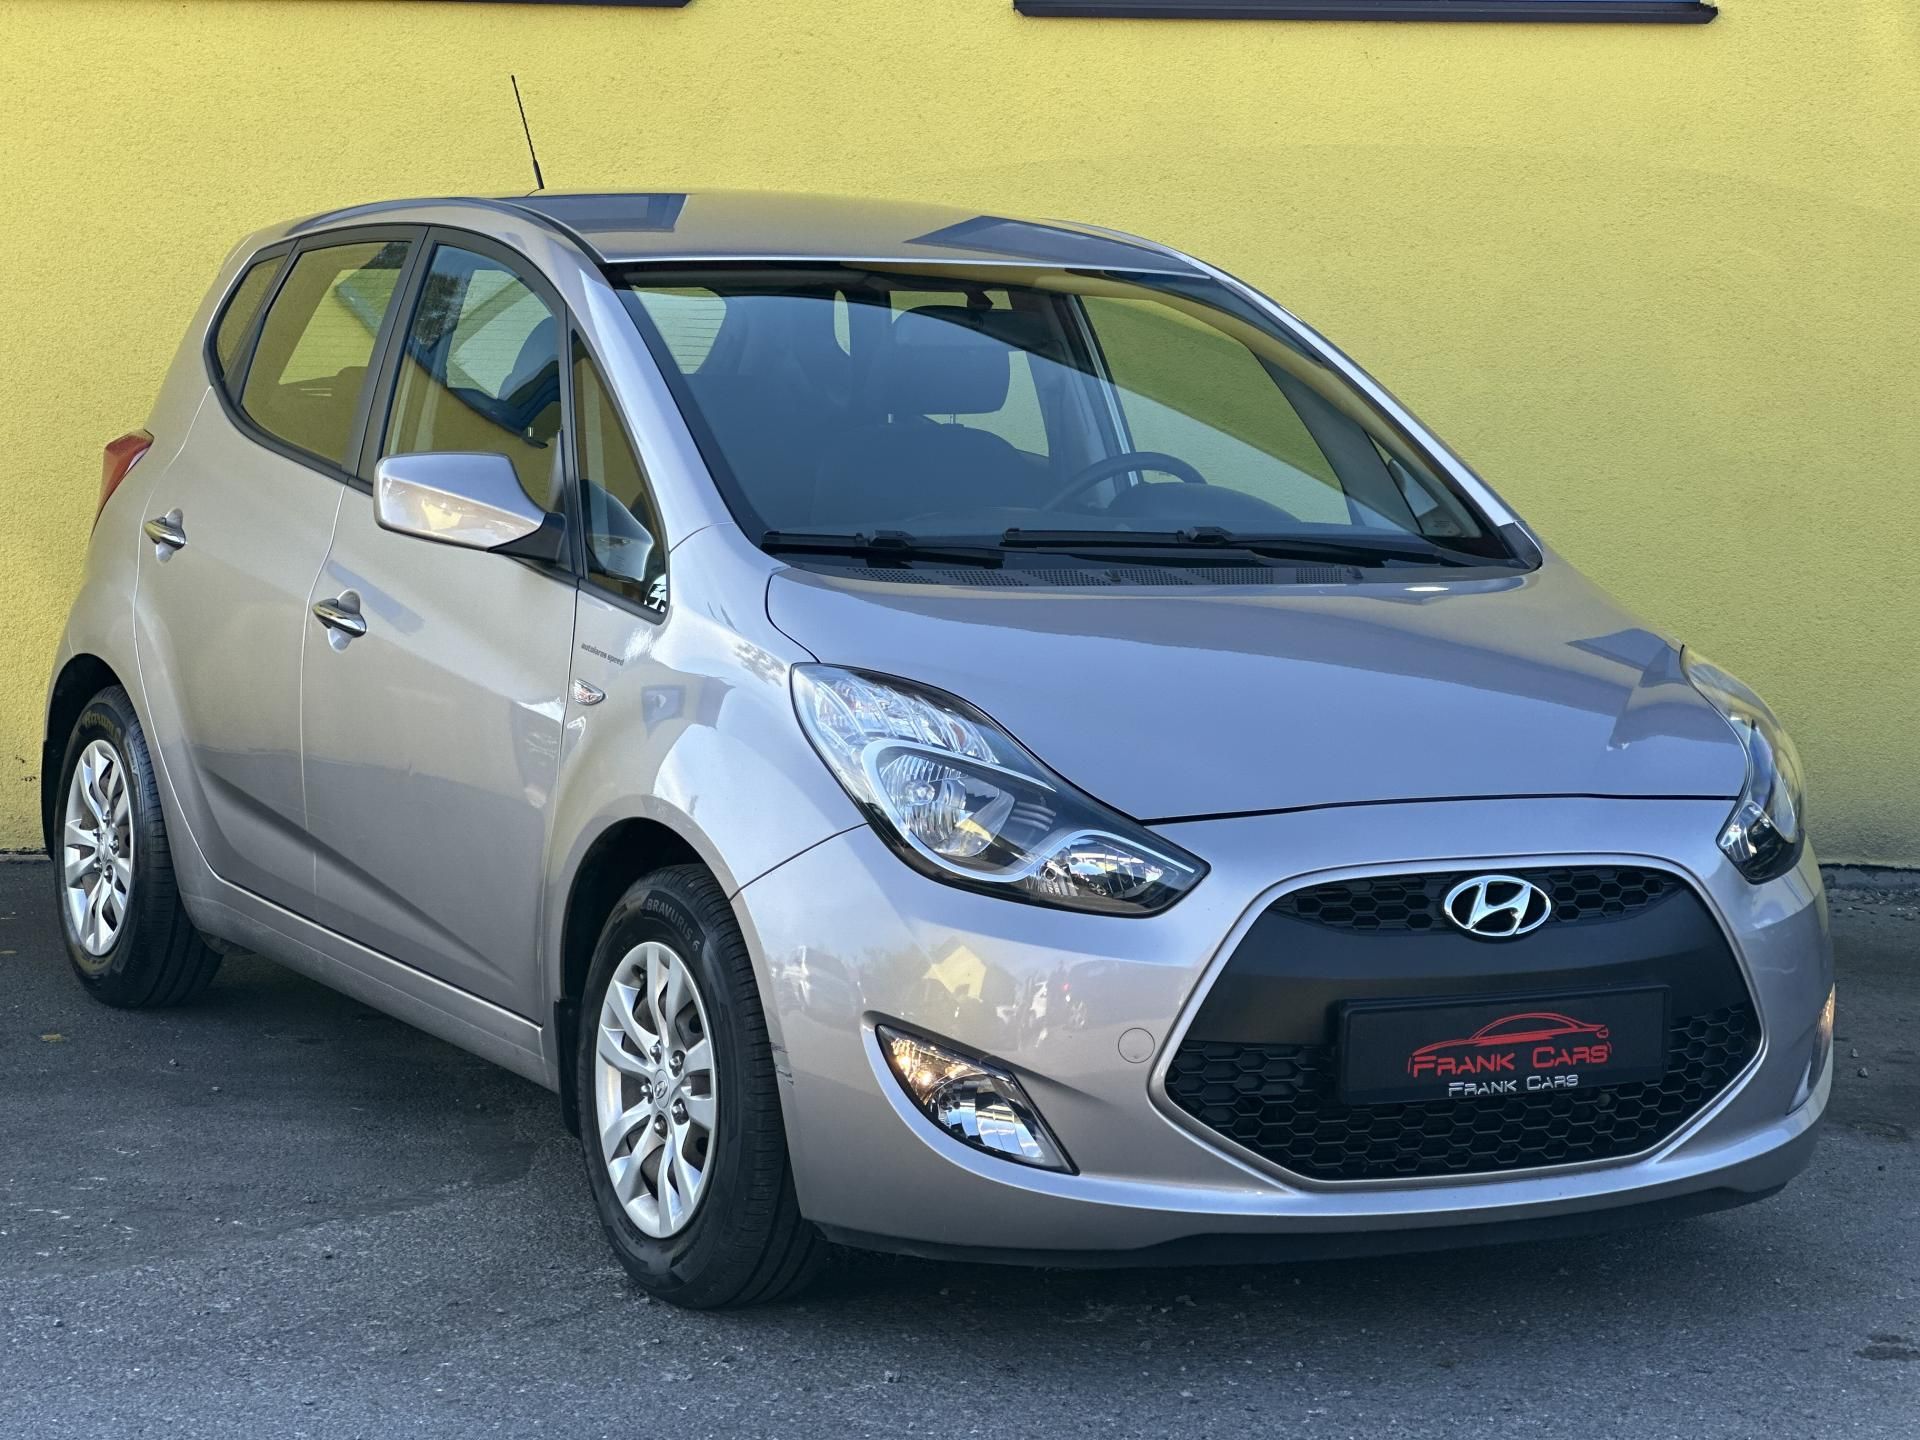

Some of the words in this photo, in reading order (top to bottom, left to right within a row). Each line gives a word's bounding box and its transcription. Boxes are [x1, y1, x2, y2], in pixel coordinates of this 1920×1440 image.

[646, 898, 694, 941] BRAVURIS
[1413, 1052, 1516, 1078] FRANK
[1532, 1045, 1609, 1069] CARS
[1448, 1080, 1517, 1097] FRANK
[1526, 1074, 1579, 1091] CARS
